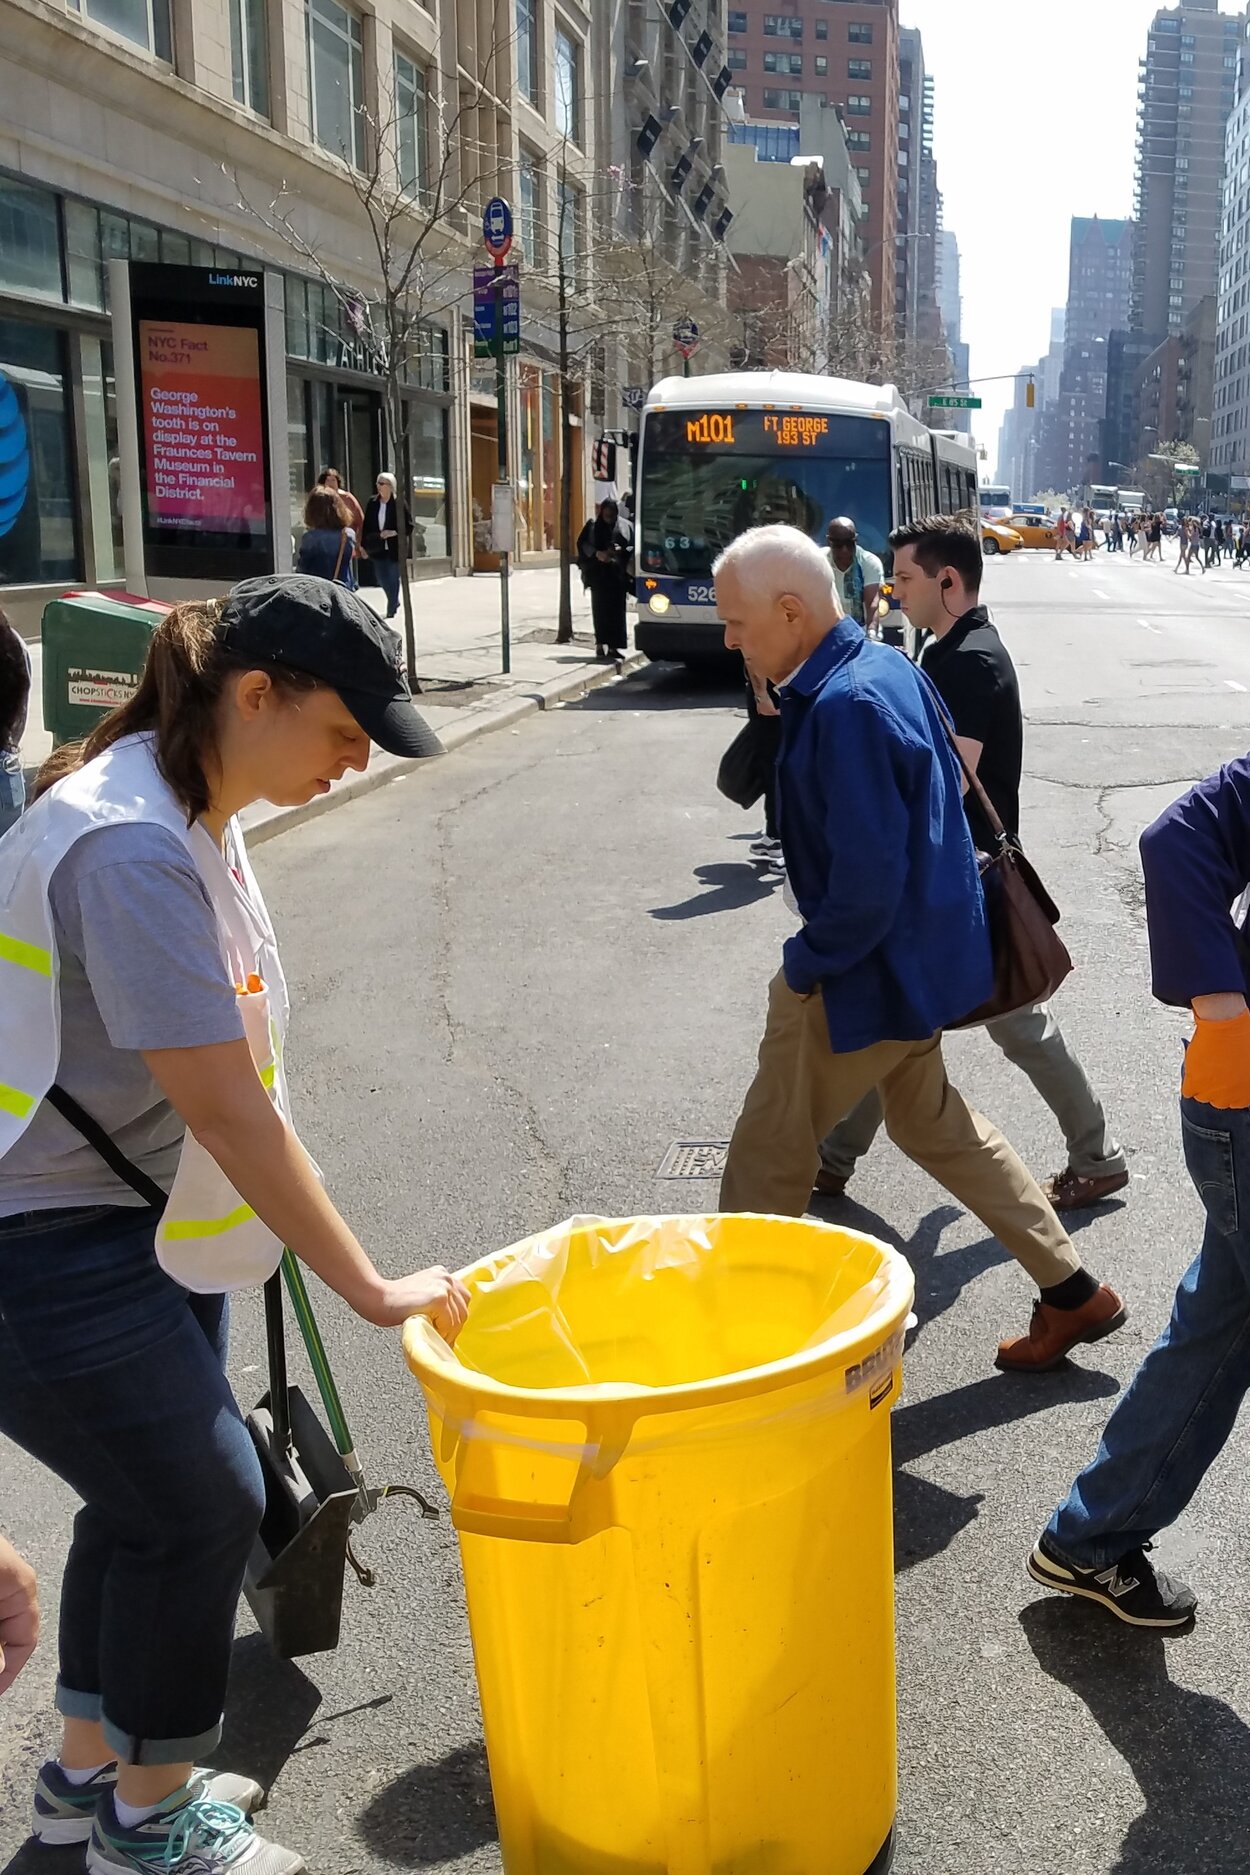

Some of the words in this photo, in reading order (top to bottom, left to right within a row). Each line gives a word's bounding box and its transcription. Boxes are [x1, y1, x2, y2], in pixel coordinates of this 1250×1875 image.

[209, 273, 258, 288] LinkNYC
[148, 336, 177, 348] NYC
[181, 339, 208, 351] Fact
[149, 350, 191, 363] No.371
[151, 387, 198, 403] George
[151, 402, 236, 419] Washington's
[152, 416, 185, 429] tooth
[189, 418, 199, 431] is
[203, 422, 219, 431] on
[687, 414, 734, 442] M101
[764, 416, 778, 431] FT
[782, 416, 828, 433] GEORGE
[153, 430, 197, 446] display
[201, 434, 213, 445] at
[216, 434, 237, 447] the
[777, 431, 798, 444] 193
[802, 432, 817, 445] ST
[154, 444, 212, 459] Fraunces
[214, 447, 256, 462] Tavern
[154, 458, 209, 473] Museum
[213, 461, 225, 473] in
[155, 472, 175, 485] the
[179, 473, 234, 488] Financial
[156, 486, 205, 500] District.
